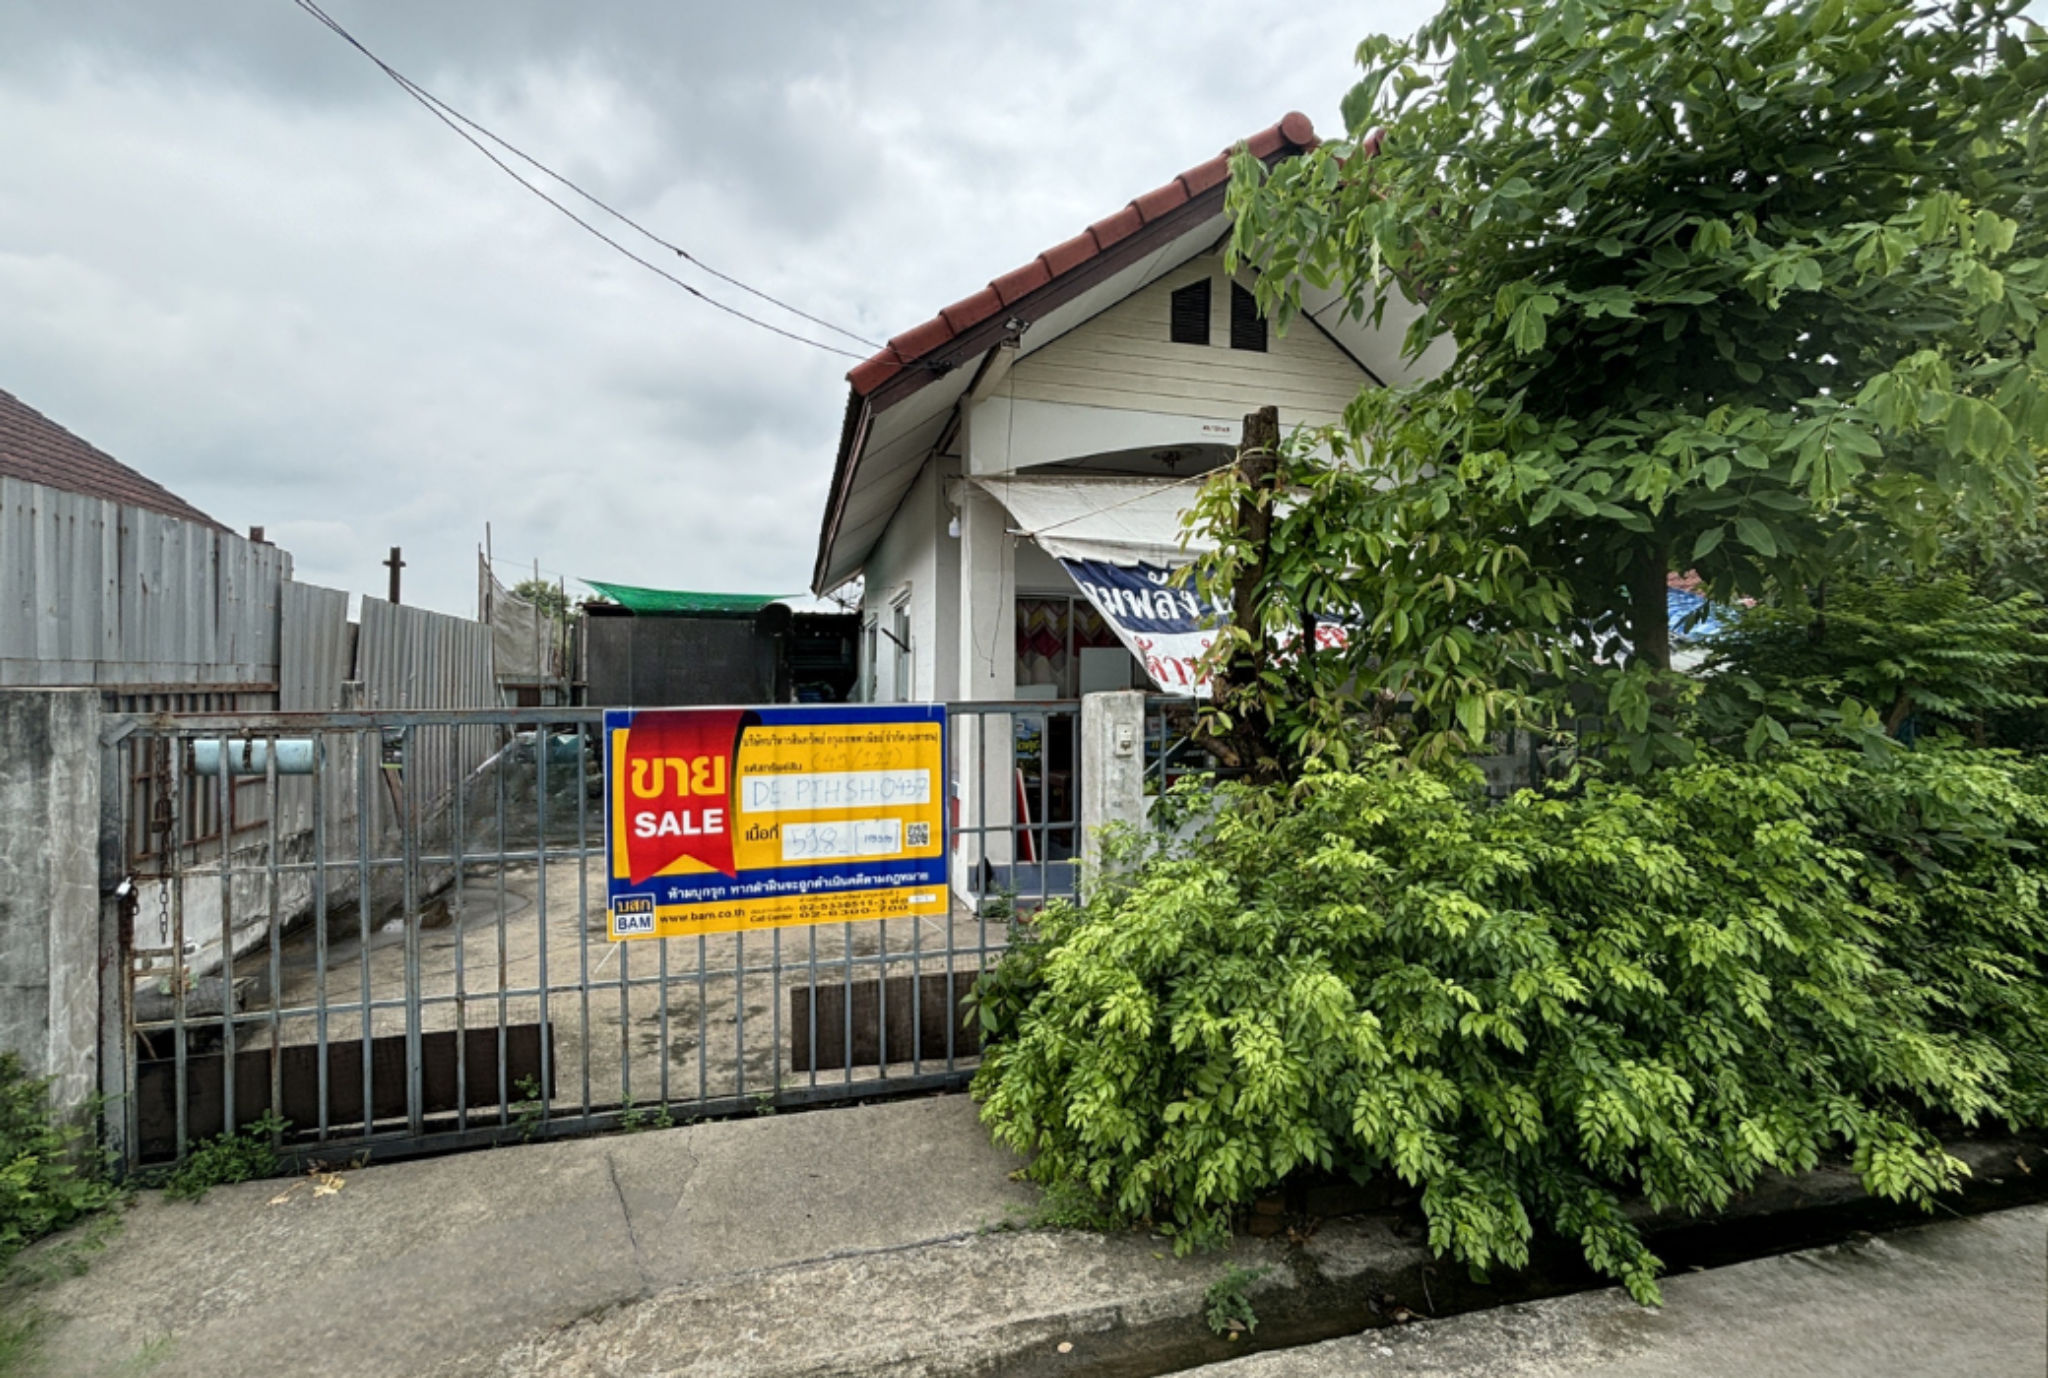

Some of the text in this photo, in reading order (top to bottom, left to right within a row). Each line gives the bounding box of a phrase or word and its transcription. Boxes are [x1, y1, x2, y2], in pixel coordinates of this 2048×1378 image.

[631, 755, 726, 799] ขาย
[634, 808, 724, 838] SALE
[667, 883, 726, 901] ห้ามบุกรุก
[616, 899, 652, 914] บสก
[617, 915, 652, 931] BAM
[659, 907, 746, 925] www.bam.co.th
